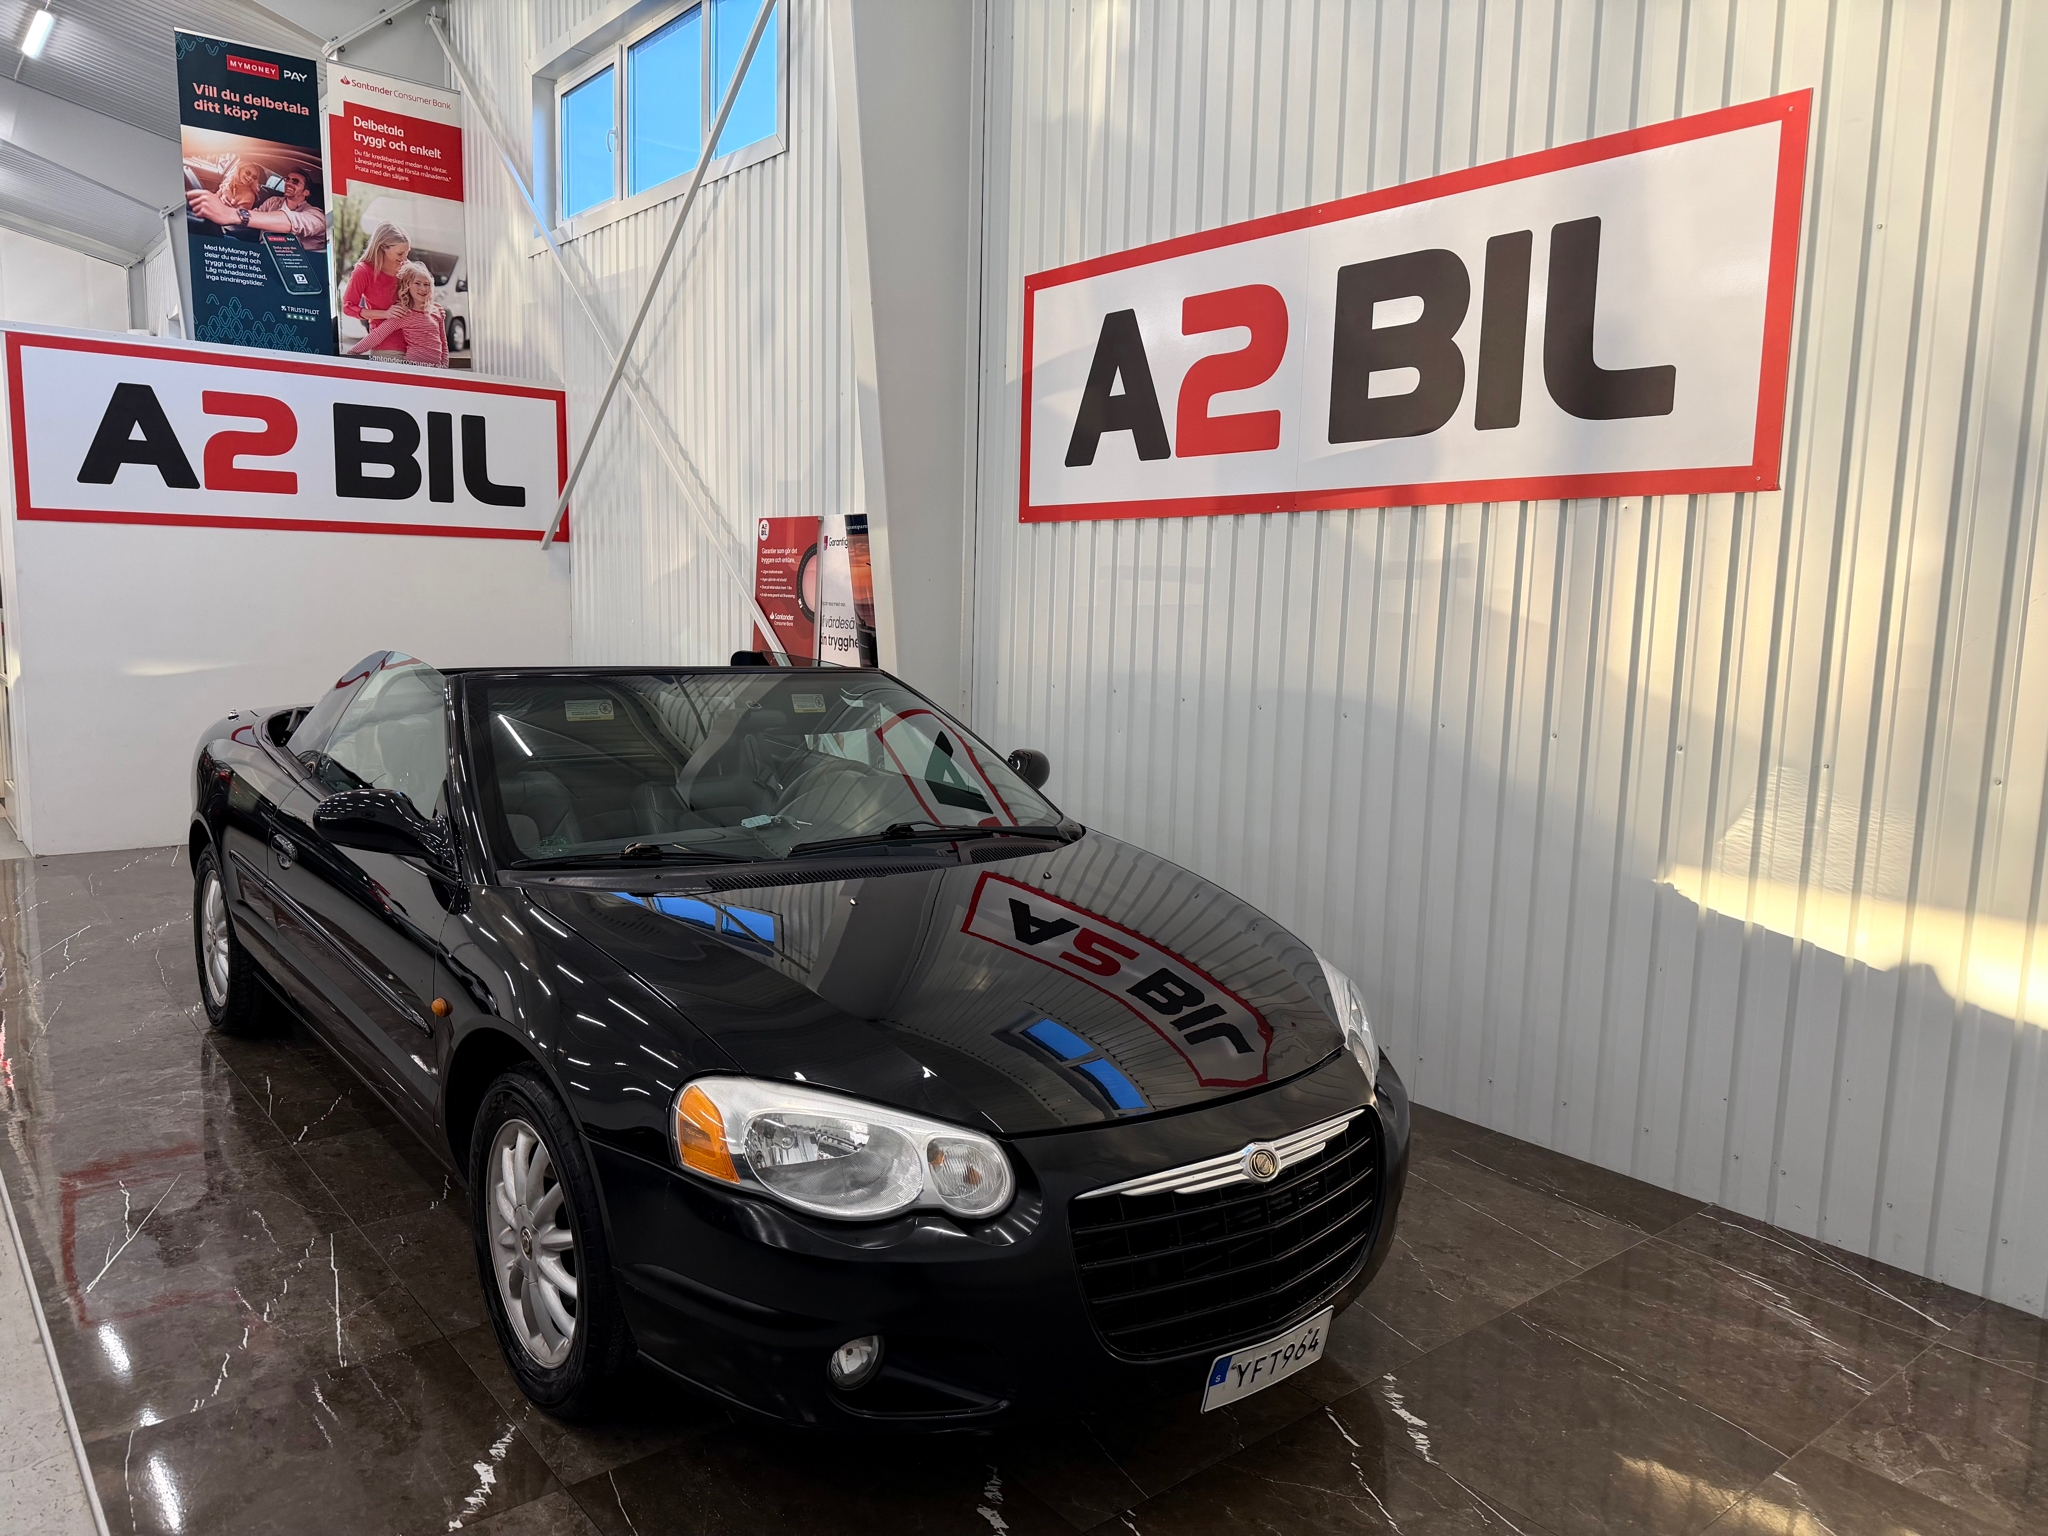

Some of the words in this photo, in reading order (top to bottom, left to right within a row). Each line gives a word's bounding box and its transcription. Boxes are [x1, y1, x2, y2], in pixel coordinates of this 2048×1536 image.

[229, 60, 276, 75] MYMONEY
[283, 70, 308, 82] PAY
[193, 83, 218, 98] Vill
[221, 89, 239, 103] du
[244, 93, 309, 116] delbetala
[351, 79, 393, 96] Santander
[393, 89, 432, 106] Consumer
[432, 98, 451, 110] Bank
[194, 99, 221, 114] ditt
[224, 103, 258, 121] köp?
[353, 116, 405, 138] Delbetala
[353, 131, 386, 149] tryggt
[388, 140, 407, 152] och
[410, 145, 442, 159] enkelt
[354, 157, 382, 168] Låneskydd
[383, 162, 396, 172] ingår
[404, 168, 420, 176] första
[354, 165, 369, 173] Prata
[370, 168, 382, 176] med
[391, 173, 410, 182] säljare.
[371, 152, 404, 165] kreditbesked
[405, 161, 423, 169] medan
[430, 166, 448, 174] väntar.
[218, 246, 248, 256] MyMoney
[249, 250, 261, 258] Pay
[230, 255, 249, 263] enkelt
[204, 259, 224, 268] tryggt
[205, 266, 217, 274] Låg
[218, 268, 268, 281] månadskostnad,
[220, 275, 265, 287] bindningstider.
[287, 306, 320, 315] TRUSTPILOT
[1064, 283, 1289, 467] A2
[1328, 215, 1676, 445] BIL
[77, 381, 298, 495] A2
[333, 402, 526, 507] BIL
[774, 612, 795, 621] Santander
[1215, 1374, 1221, 1383] S
[1237, 1326, 1321, 1388] YFT964
